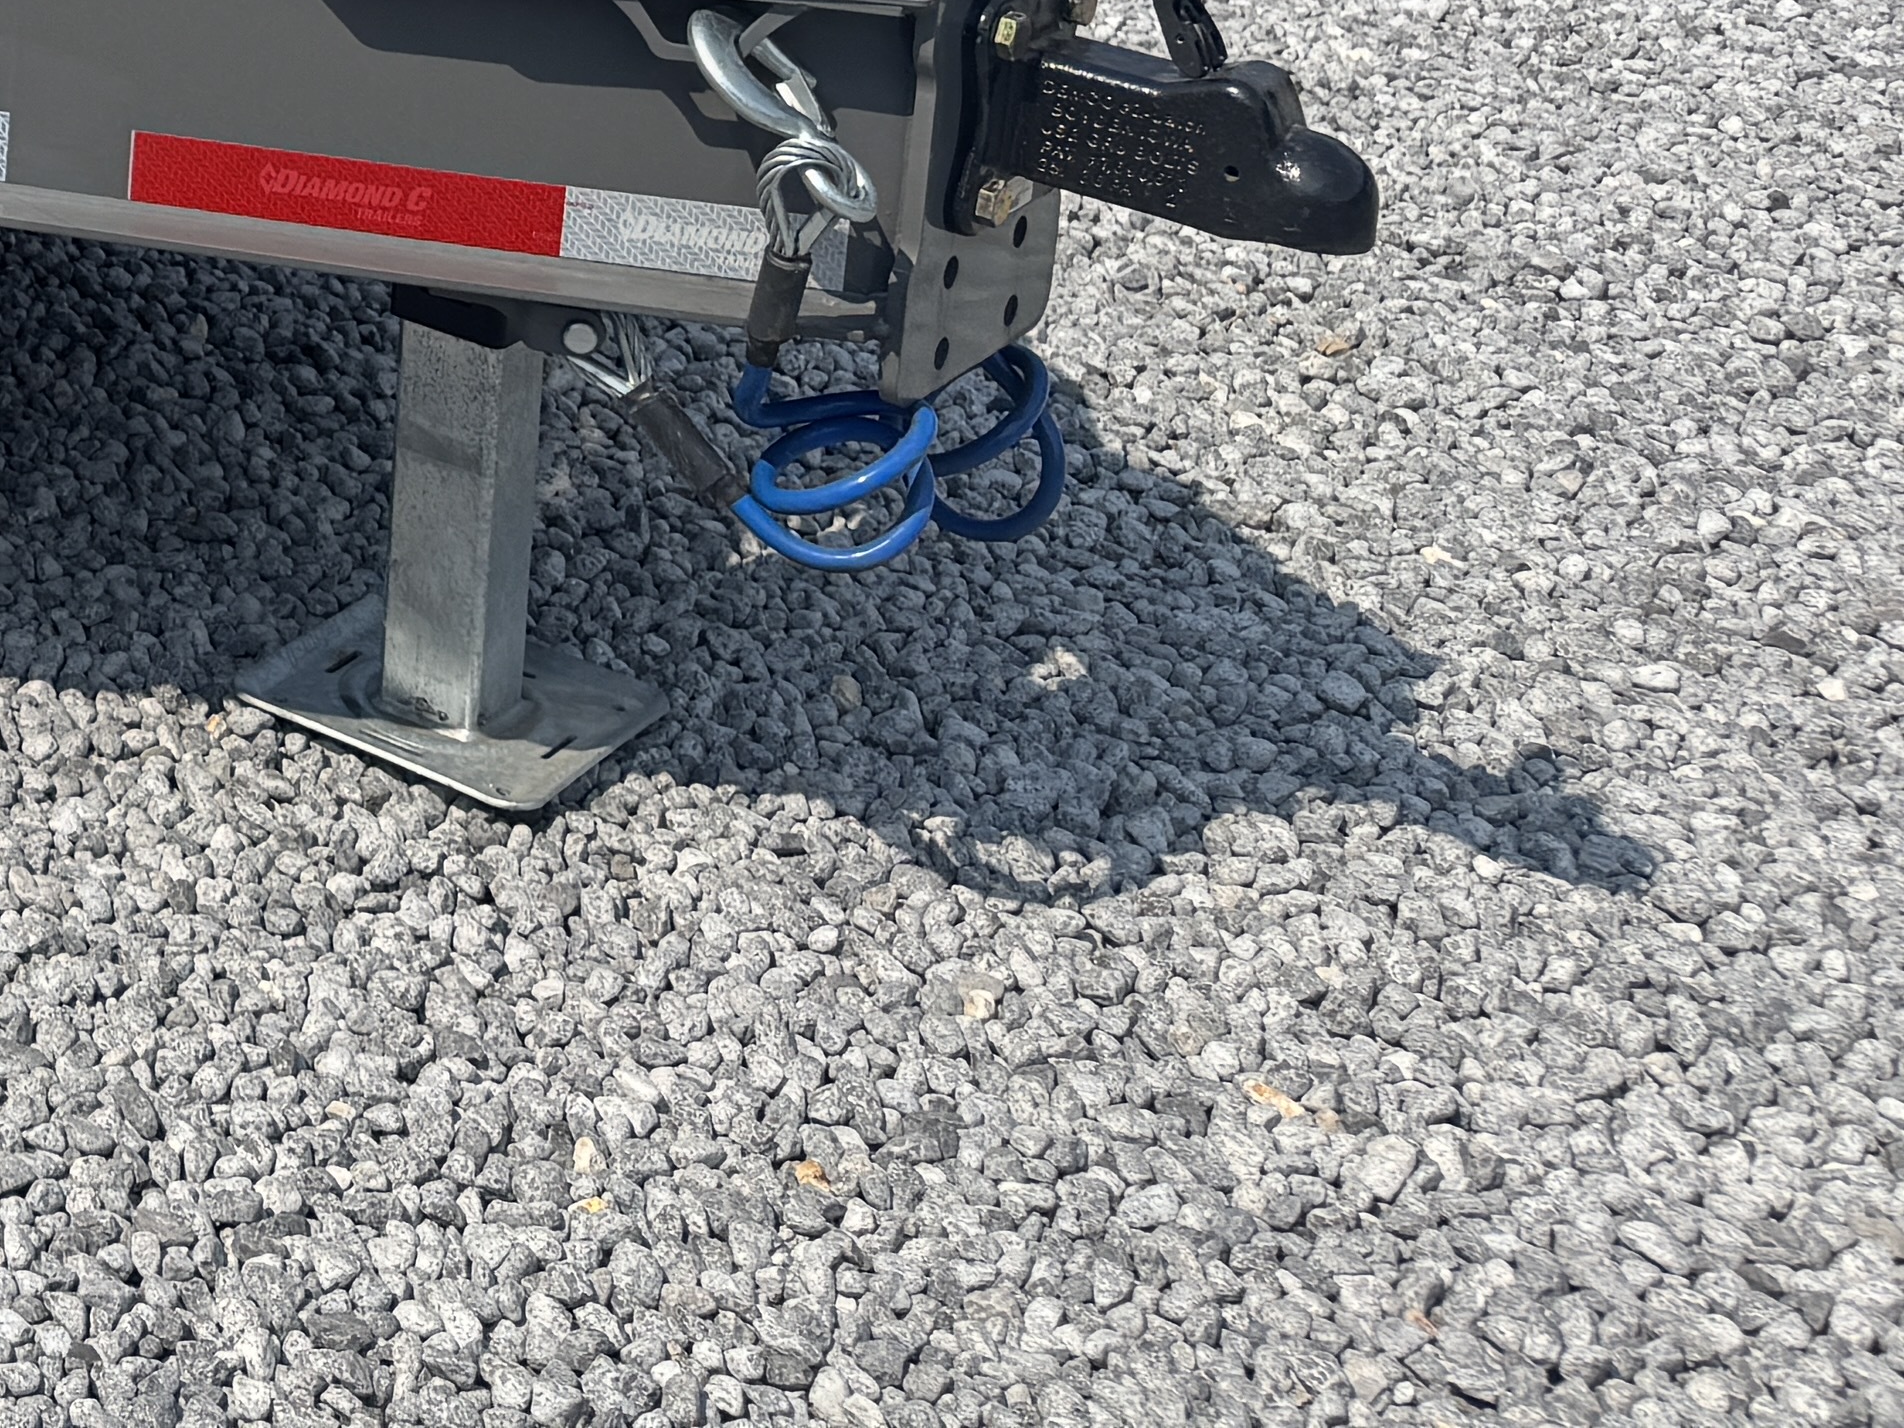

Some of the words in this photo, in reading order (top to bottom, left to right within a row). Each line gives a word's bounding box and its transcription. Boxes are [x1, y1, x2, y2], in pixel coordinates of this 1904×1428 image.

[272, 168, 402, 207] DIAMOND
[406, 187, 432, 211] C
[355, 207, 424, 226] TRAILERS
